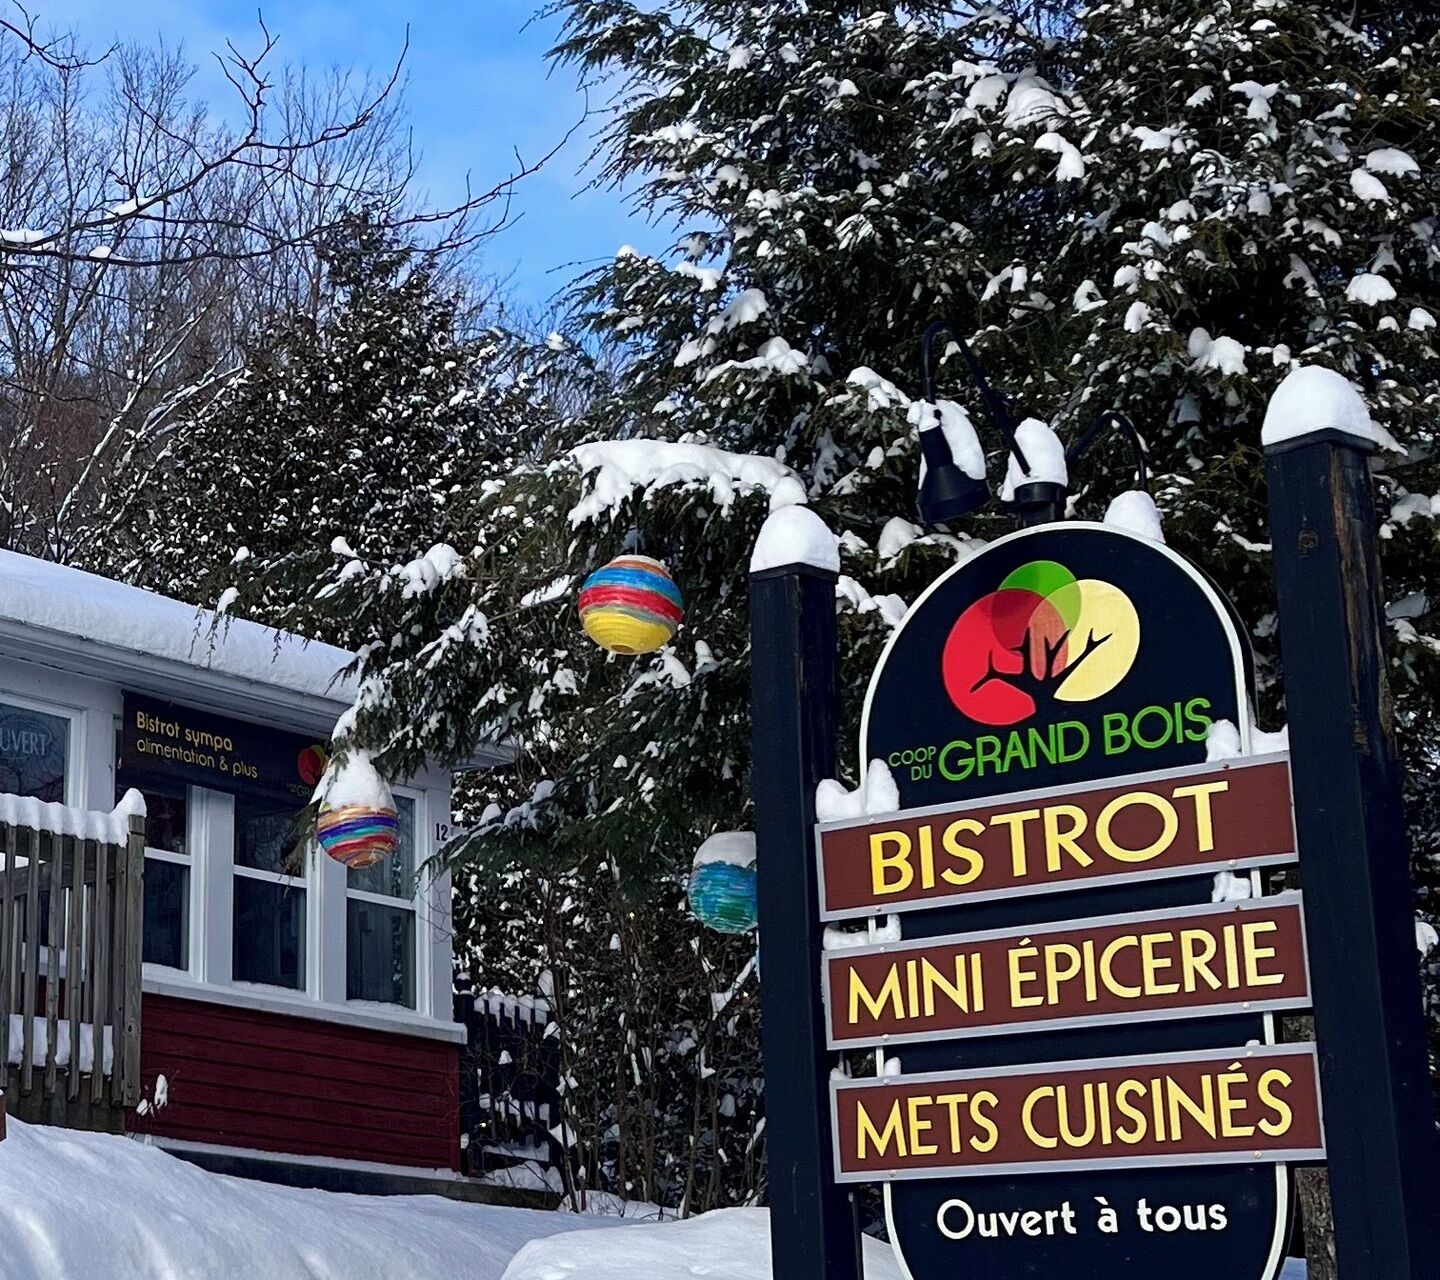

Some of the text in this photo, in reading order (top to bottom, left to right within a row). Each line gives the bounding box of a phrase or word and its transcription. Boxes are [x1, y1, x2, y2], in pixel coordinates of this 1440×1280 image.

[136, 710, 233, 751] Bistrot sympa
[938, 699, 1212, 781] GRAND BOIS
[136, 738, 258, 779] alimentation & plus
[888, 746, 937, 768] COOP
[910, 764, 933, 781] DU
[869, 780, 1229, 895] BISTROT
[849, 921, 1285, 1024] MINI ÉPICERIE
[857, 1062, 1293, 1159] METS CUISINÉS
[936, 1195, 1228, 1239] Ouvert à tous
